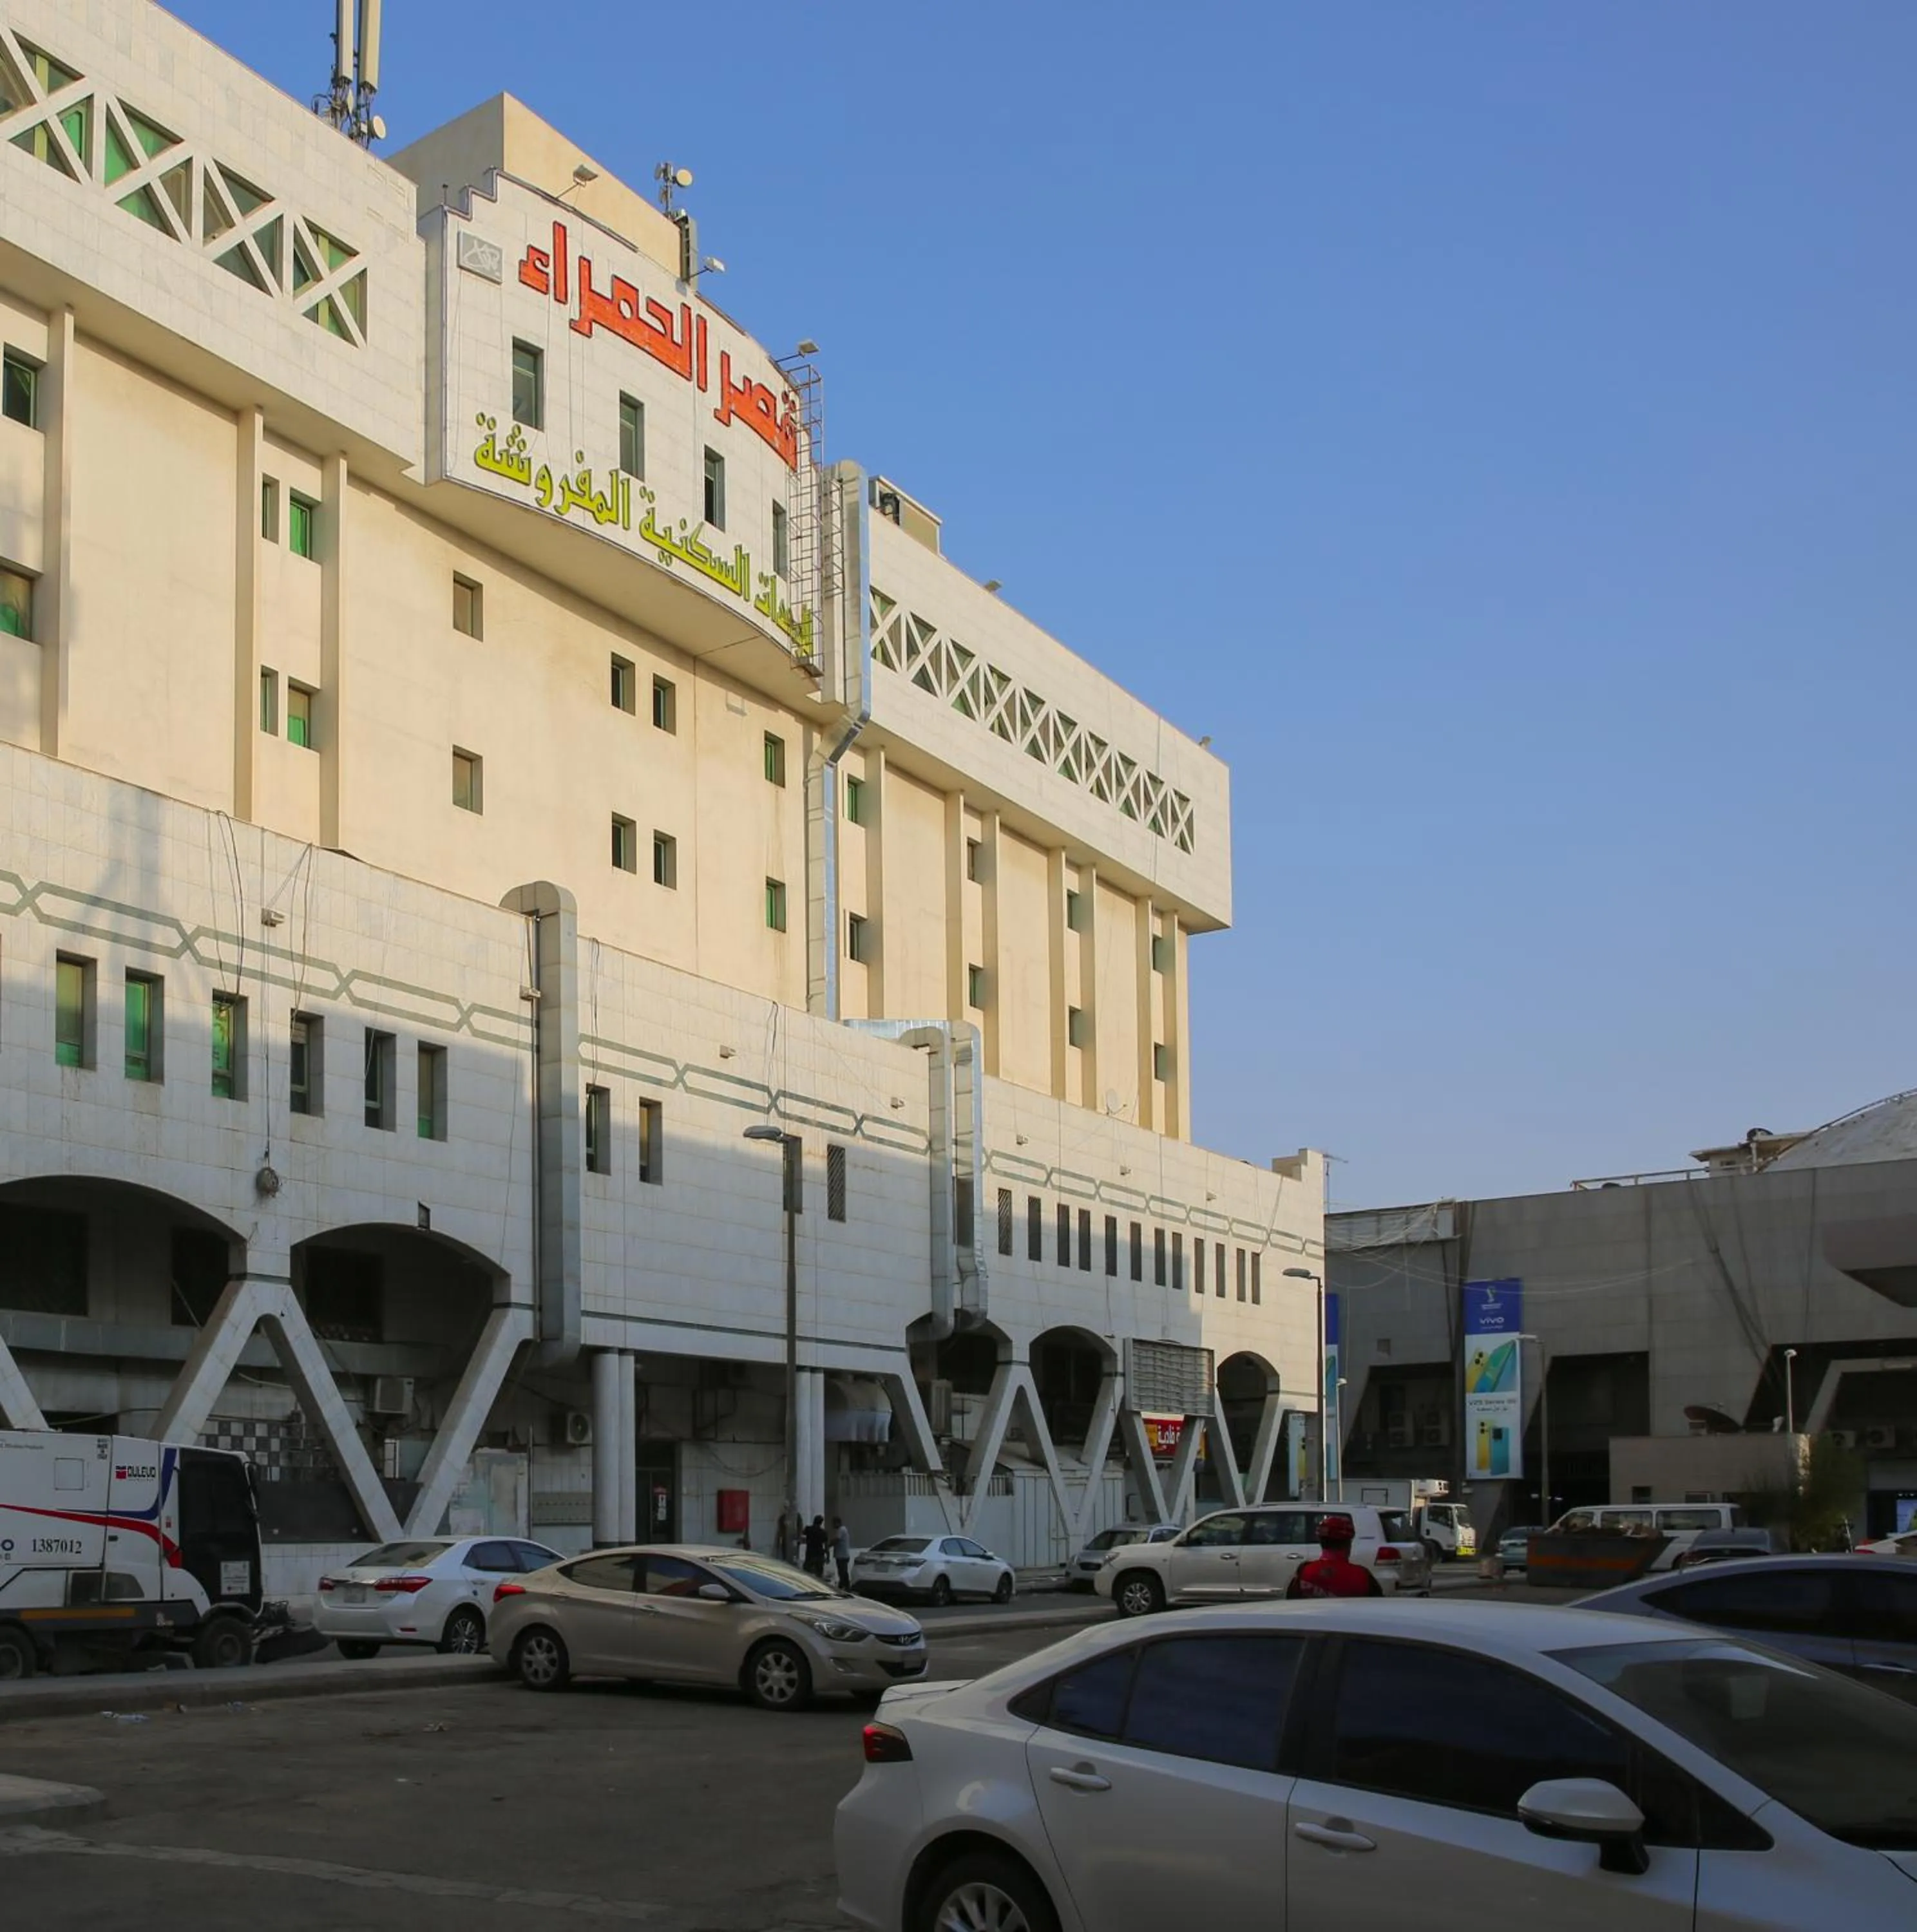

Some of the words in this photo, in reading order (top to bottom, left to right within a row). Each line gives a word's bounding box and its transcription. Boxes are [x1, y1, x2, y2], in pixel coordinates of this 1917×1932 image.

[519, 220, 707, 393] الحمراء
[473, 411, 631, 531] المفروشة
[714, 350, 798, 472] قصر
[638, 485, 750, 602] السكنية
[32, 1539, 82, 1554] 1387012
